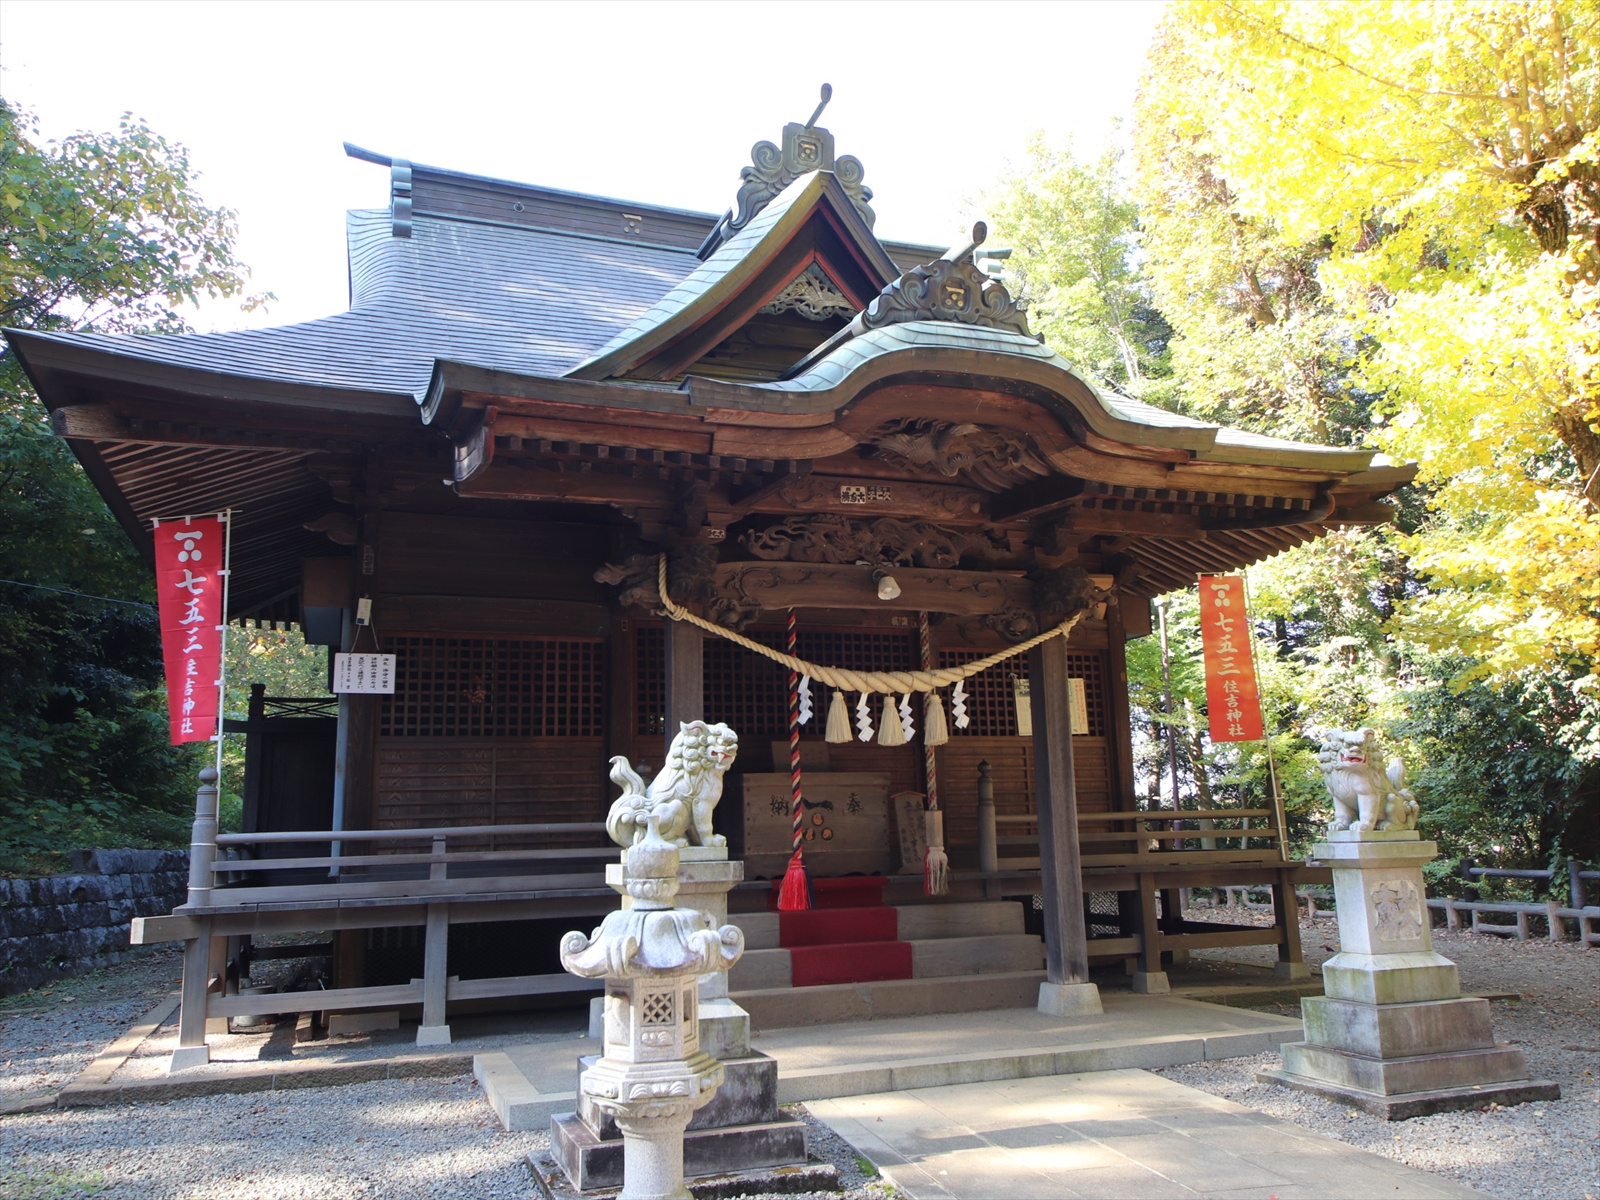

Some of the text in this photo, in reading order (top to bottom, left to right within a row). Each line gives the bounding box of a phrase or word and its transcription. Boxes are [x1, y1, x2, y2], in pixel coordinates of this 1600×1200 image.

[175, 568, 207, 654] 七五三
[1214, 612, 1241, 676] 七五三
[1222, 680, 1246, 738] 住吉神社
